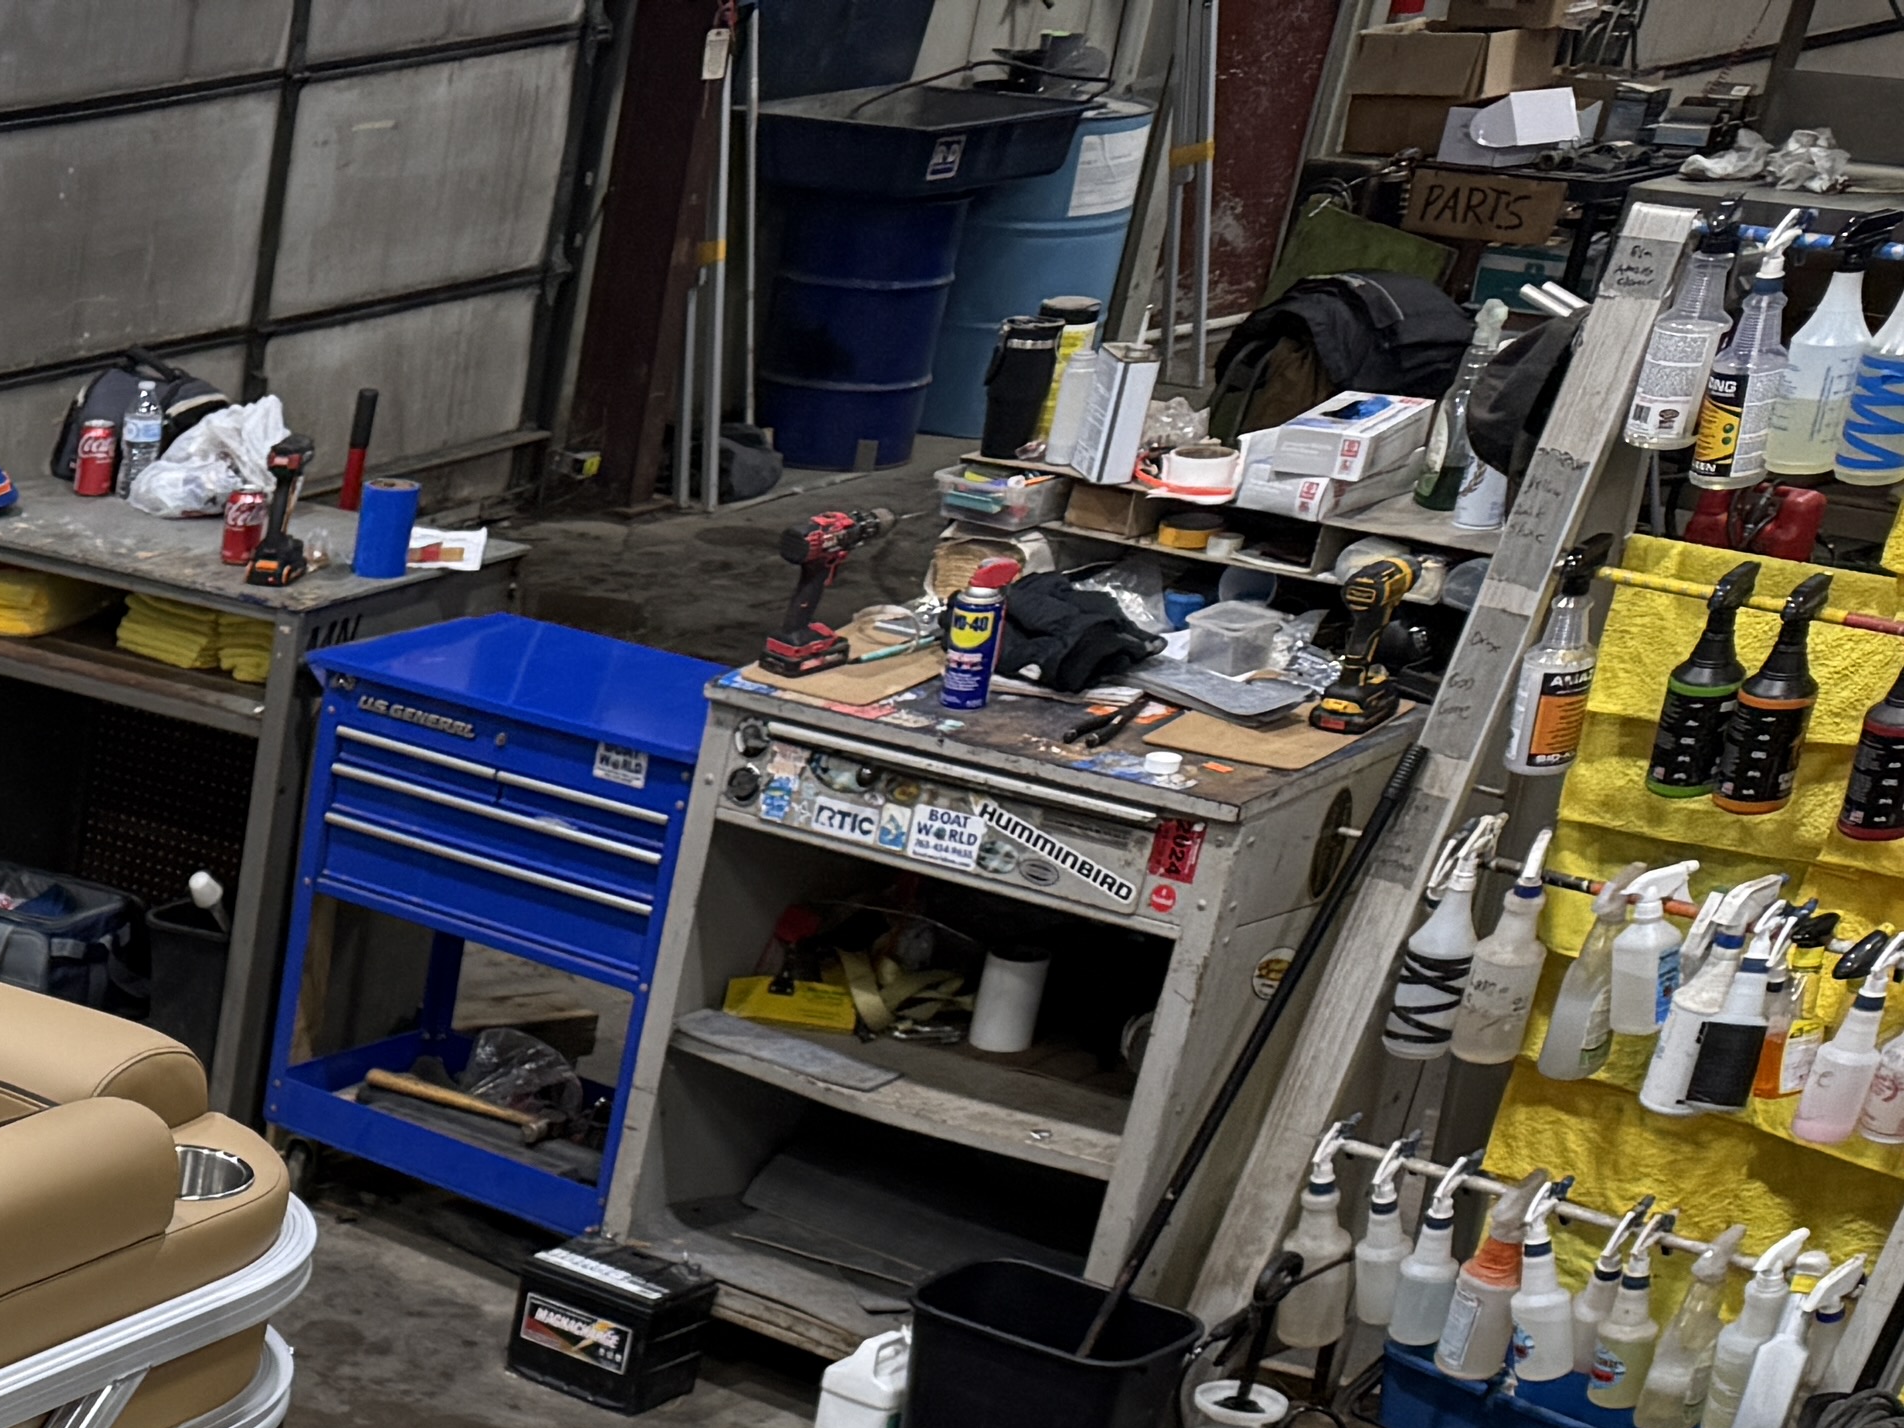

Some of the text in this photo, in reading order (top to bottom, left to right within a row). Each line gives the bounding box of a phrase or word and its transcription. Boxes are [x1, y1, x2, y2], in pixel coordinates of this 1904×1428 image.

[1419, 184, 1533, 231] PARTS
[953, 614, 990, 632] WD-40
[815, 805, 875, 837] RTIC
[928, 808, 971, 829] BOAT
[979, 802, 1134, 902] HUMMINBIRD
